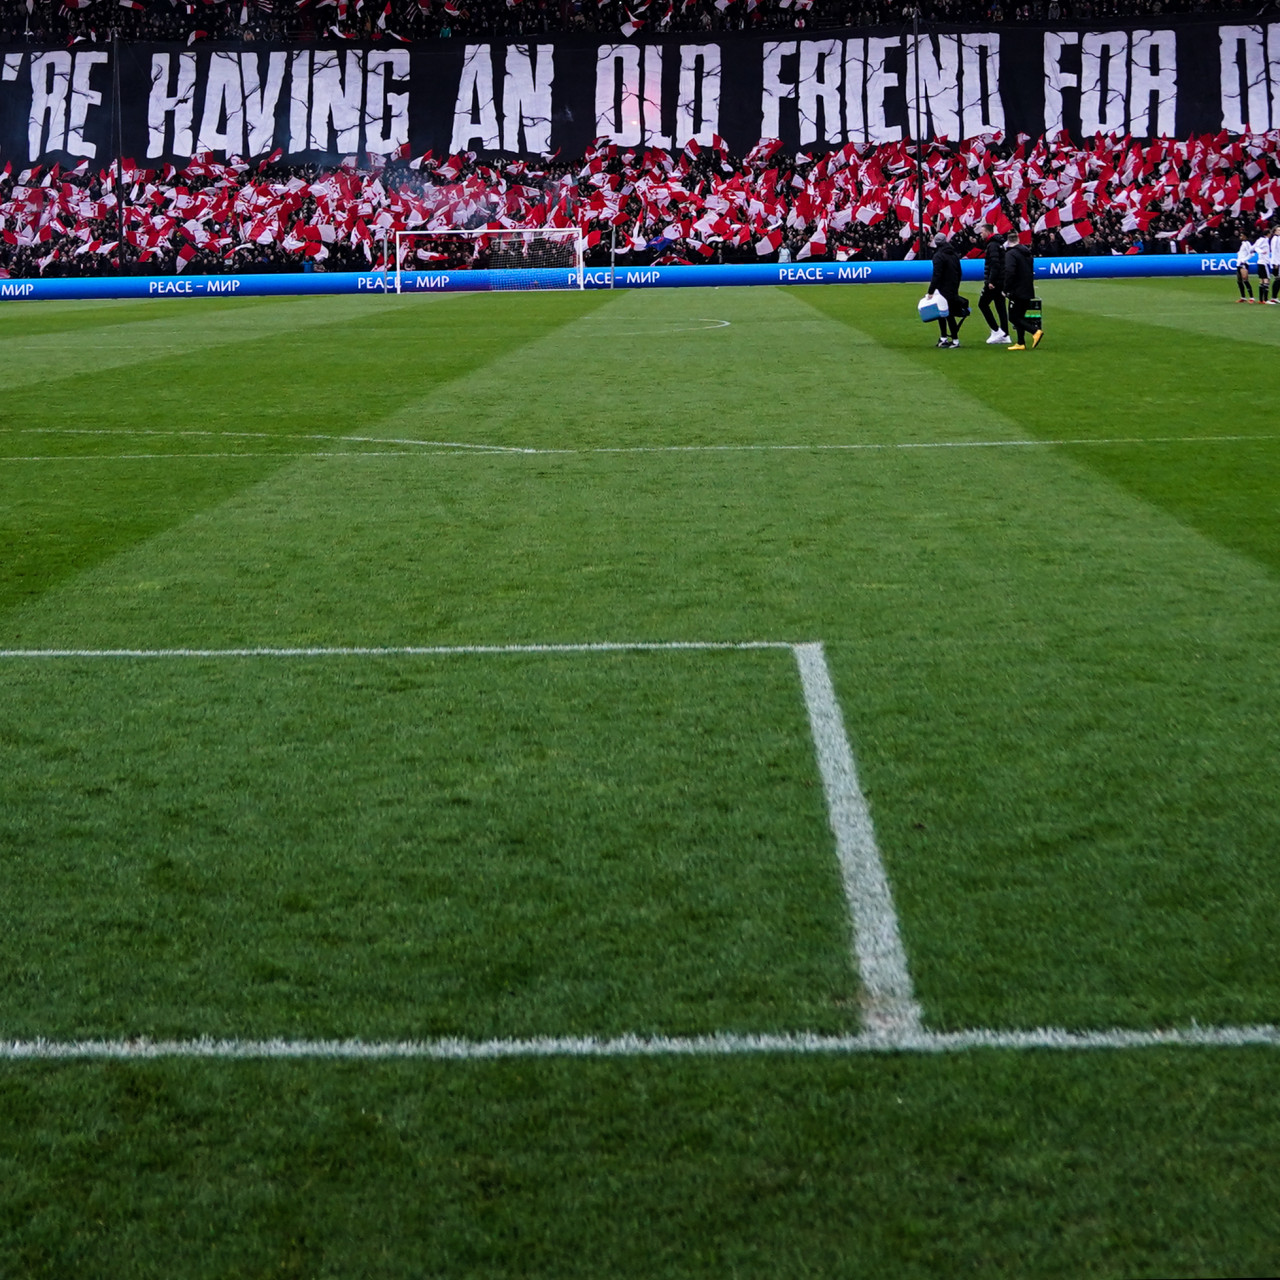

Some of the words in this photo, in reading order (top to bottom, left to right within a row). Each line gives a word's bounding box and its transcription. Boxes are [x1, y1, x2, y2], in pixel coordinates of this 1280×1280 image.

[147, 48, 412, 157] HAVING
[450, 43, 555, 151] AN
[595, 43, 721, 148] OLD
[762, 32, 1005, 149] FRIEND
[1044, 30, 1178, 140] FOR
[1049, 261, 1084, 275] МИР
[1201, 258, 1239, 271] PEAC
[626, 271, 661, 284] МИР
[780, 268, 823, 281] PEACE
[838, 266, 872, 279] МИР
[149, 281, 192, 295] PEACE
[206, 279, 241, 293] МИР
[416, 275, 450, 288] МИР
[0, 283, 35, 297] МИР
